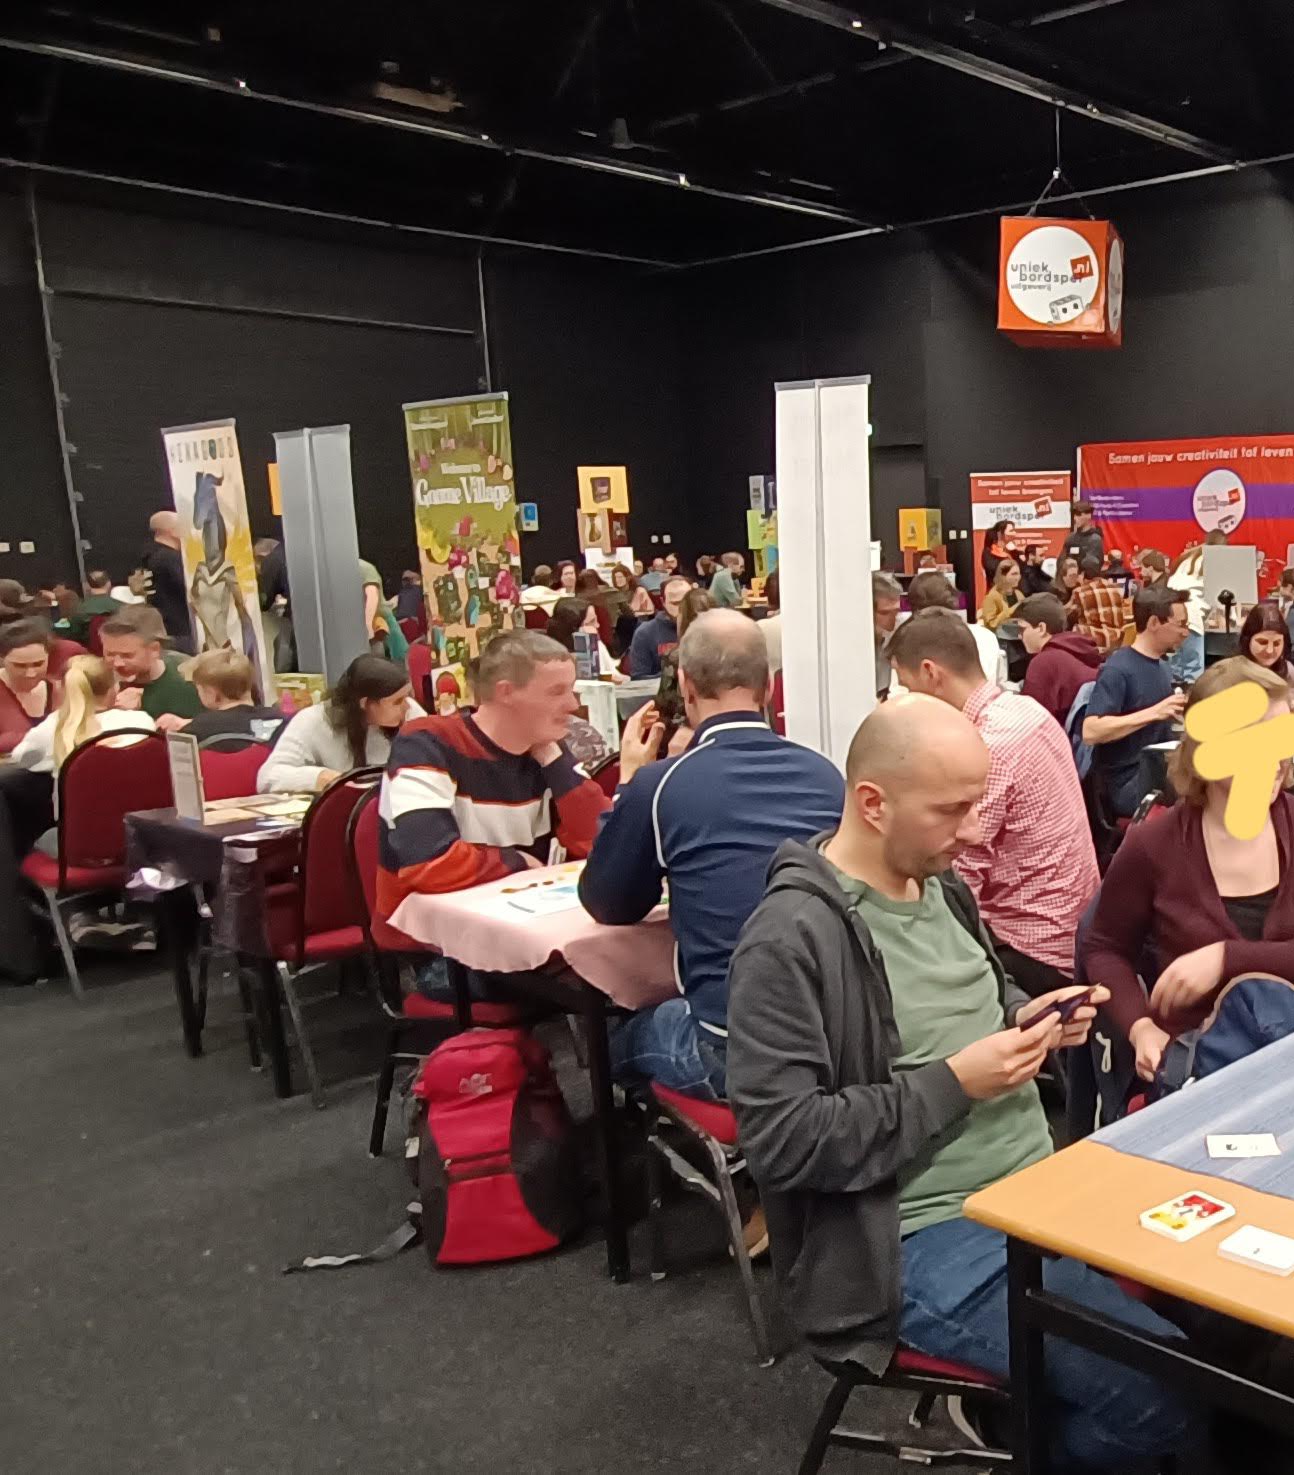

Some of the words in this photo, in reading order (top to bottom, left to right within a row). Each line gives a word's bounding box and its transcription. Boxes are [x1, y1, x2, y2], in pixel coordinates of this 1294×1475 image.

[1010, 261, 1048, 272] uniek
[1108, 452, 1145, 464] Samen
[1176, 447, 1237, 462] creativiteit
